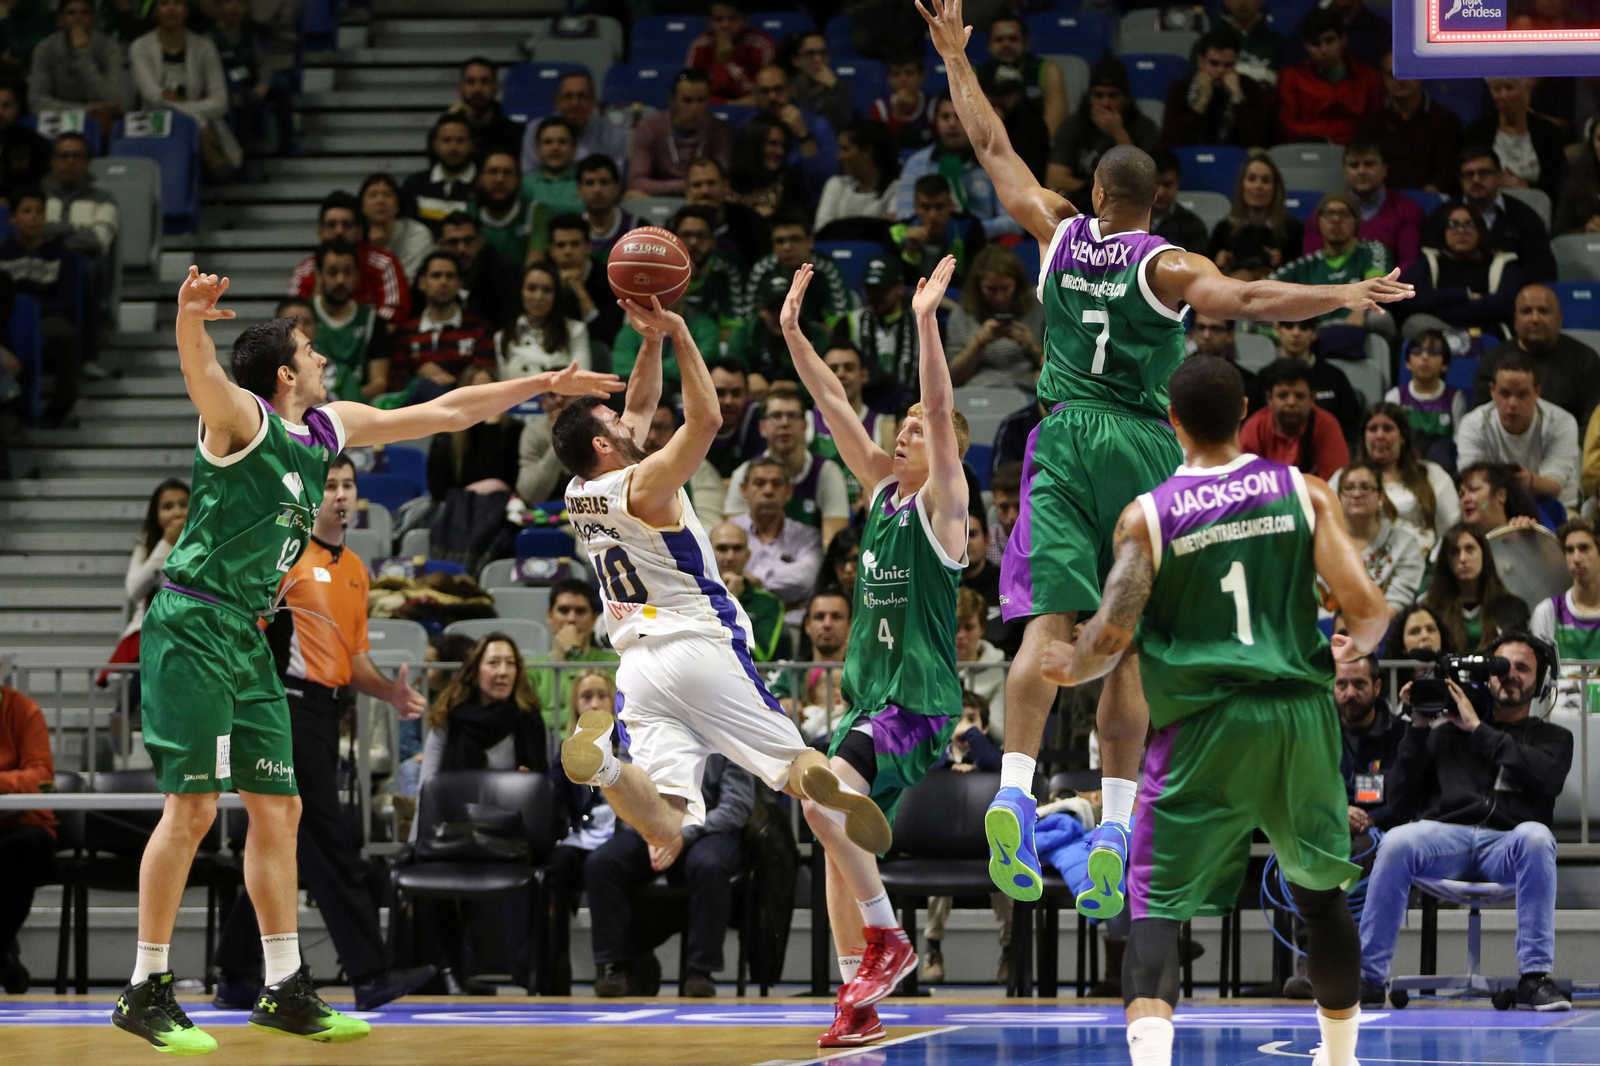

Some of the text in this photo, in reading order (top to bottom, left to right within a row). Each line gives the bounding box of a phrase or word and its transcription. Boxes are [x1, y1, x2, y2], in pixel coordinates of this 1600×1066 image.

[1461, 6, 1502, 18] endesa
[1082, 309, 1110, 375] 7
[1170, 470, 1279, 517] JACKSON
[276, 536, 301, 573] 12
[594, 545, 649, 605] 10
[1219, 560, 1255, 646] 1
[877, 617, 895, 650] 4
[183, 772, 209, 781] SPALDING
